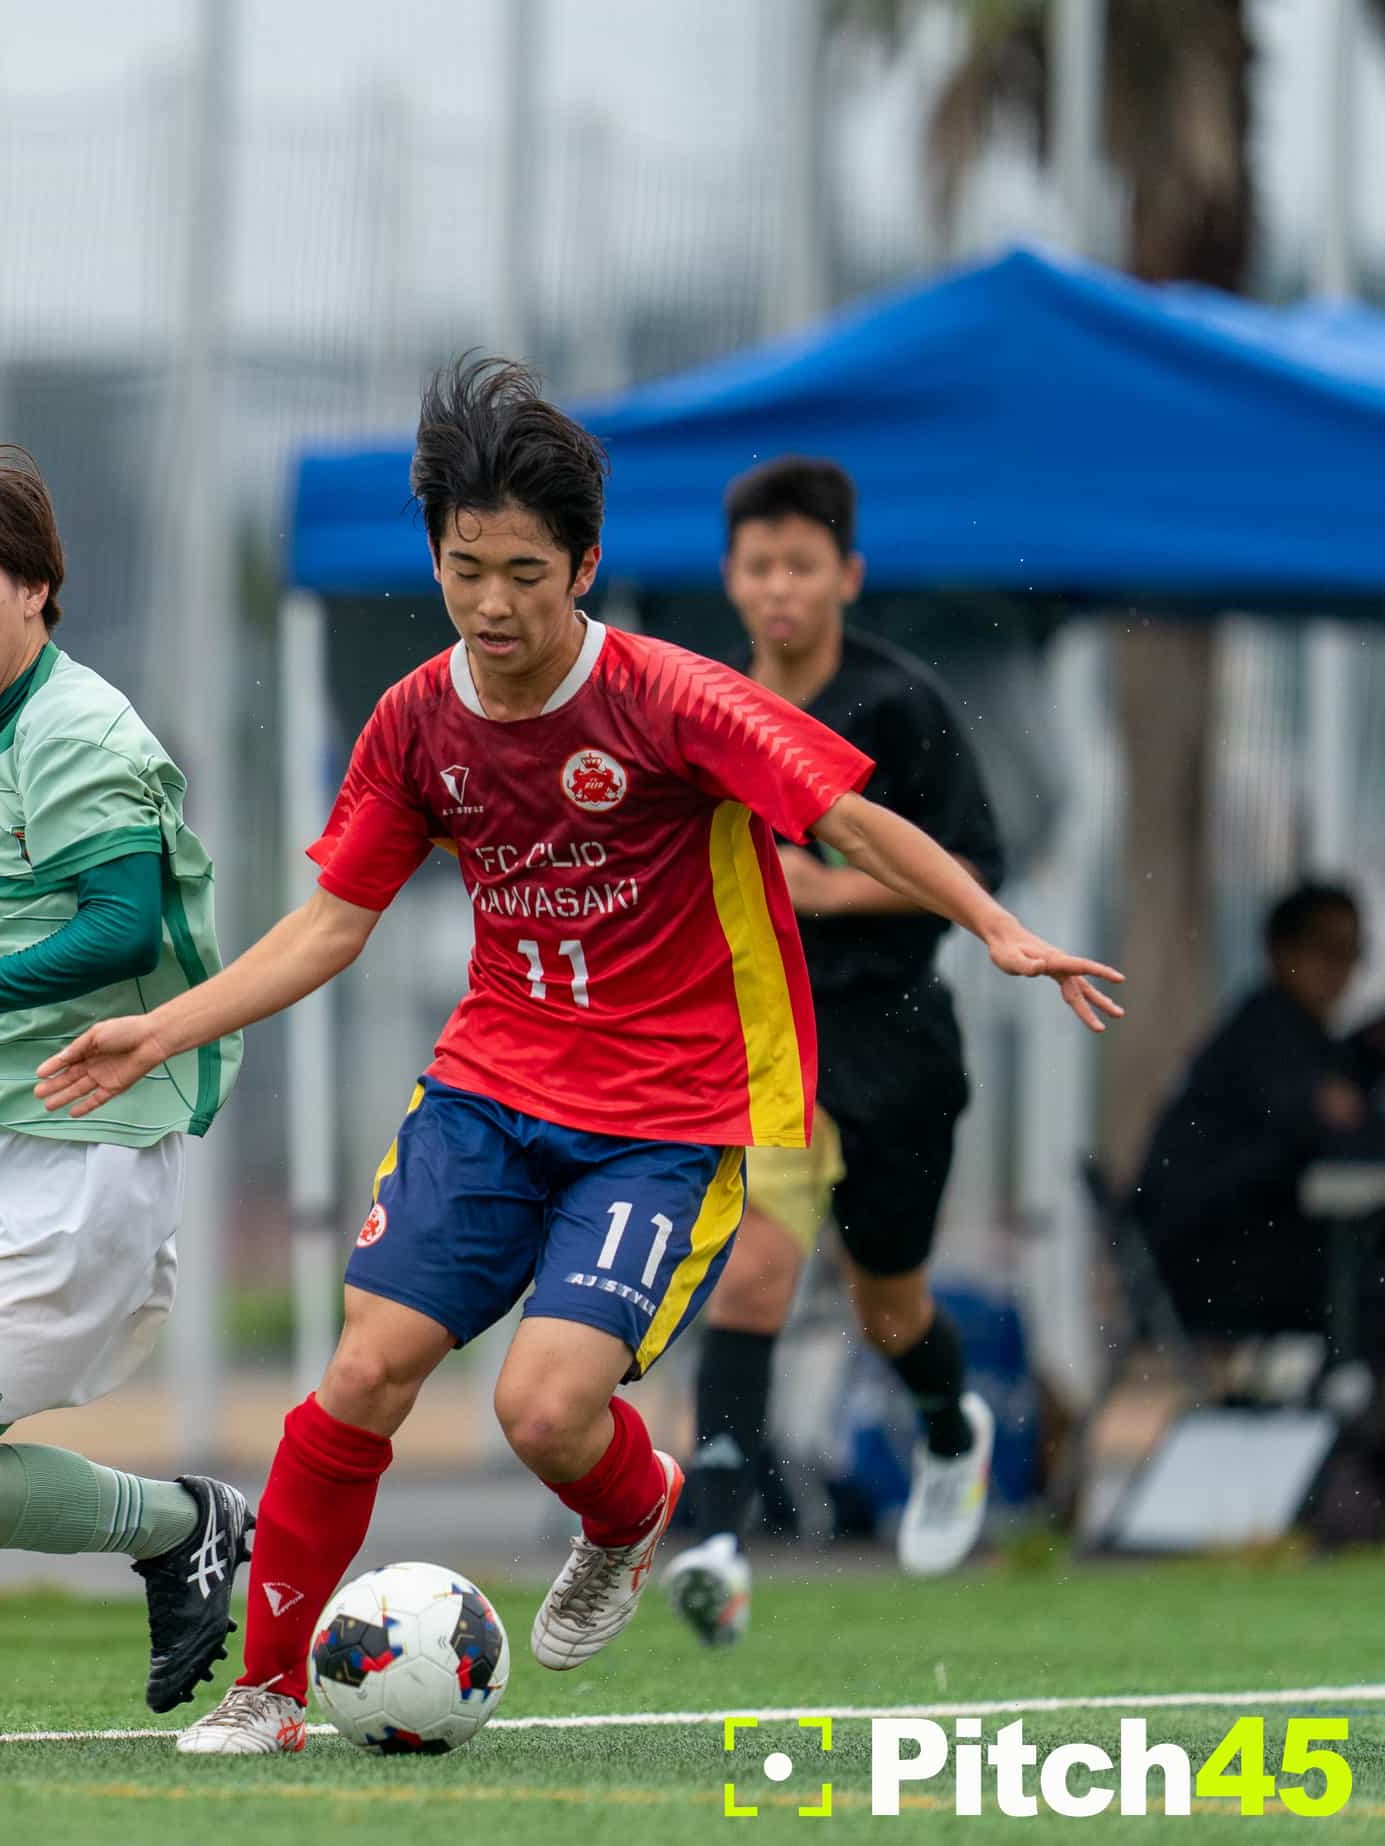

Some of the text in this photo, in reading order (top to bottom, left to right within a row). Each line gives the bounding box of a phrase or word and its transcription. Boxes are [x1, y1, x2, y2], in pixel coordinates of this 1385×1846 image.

[476, 841, 607, 873] FC CLIO
[517, 939, 590, 1009] 11
[596, 1201, 673, 1289] 11
[568, 1271, 598, 1287] AJ
